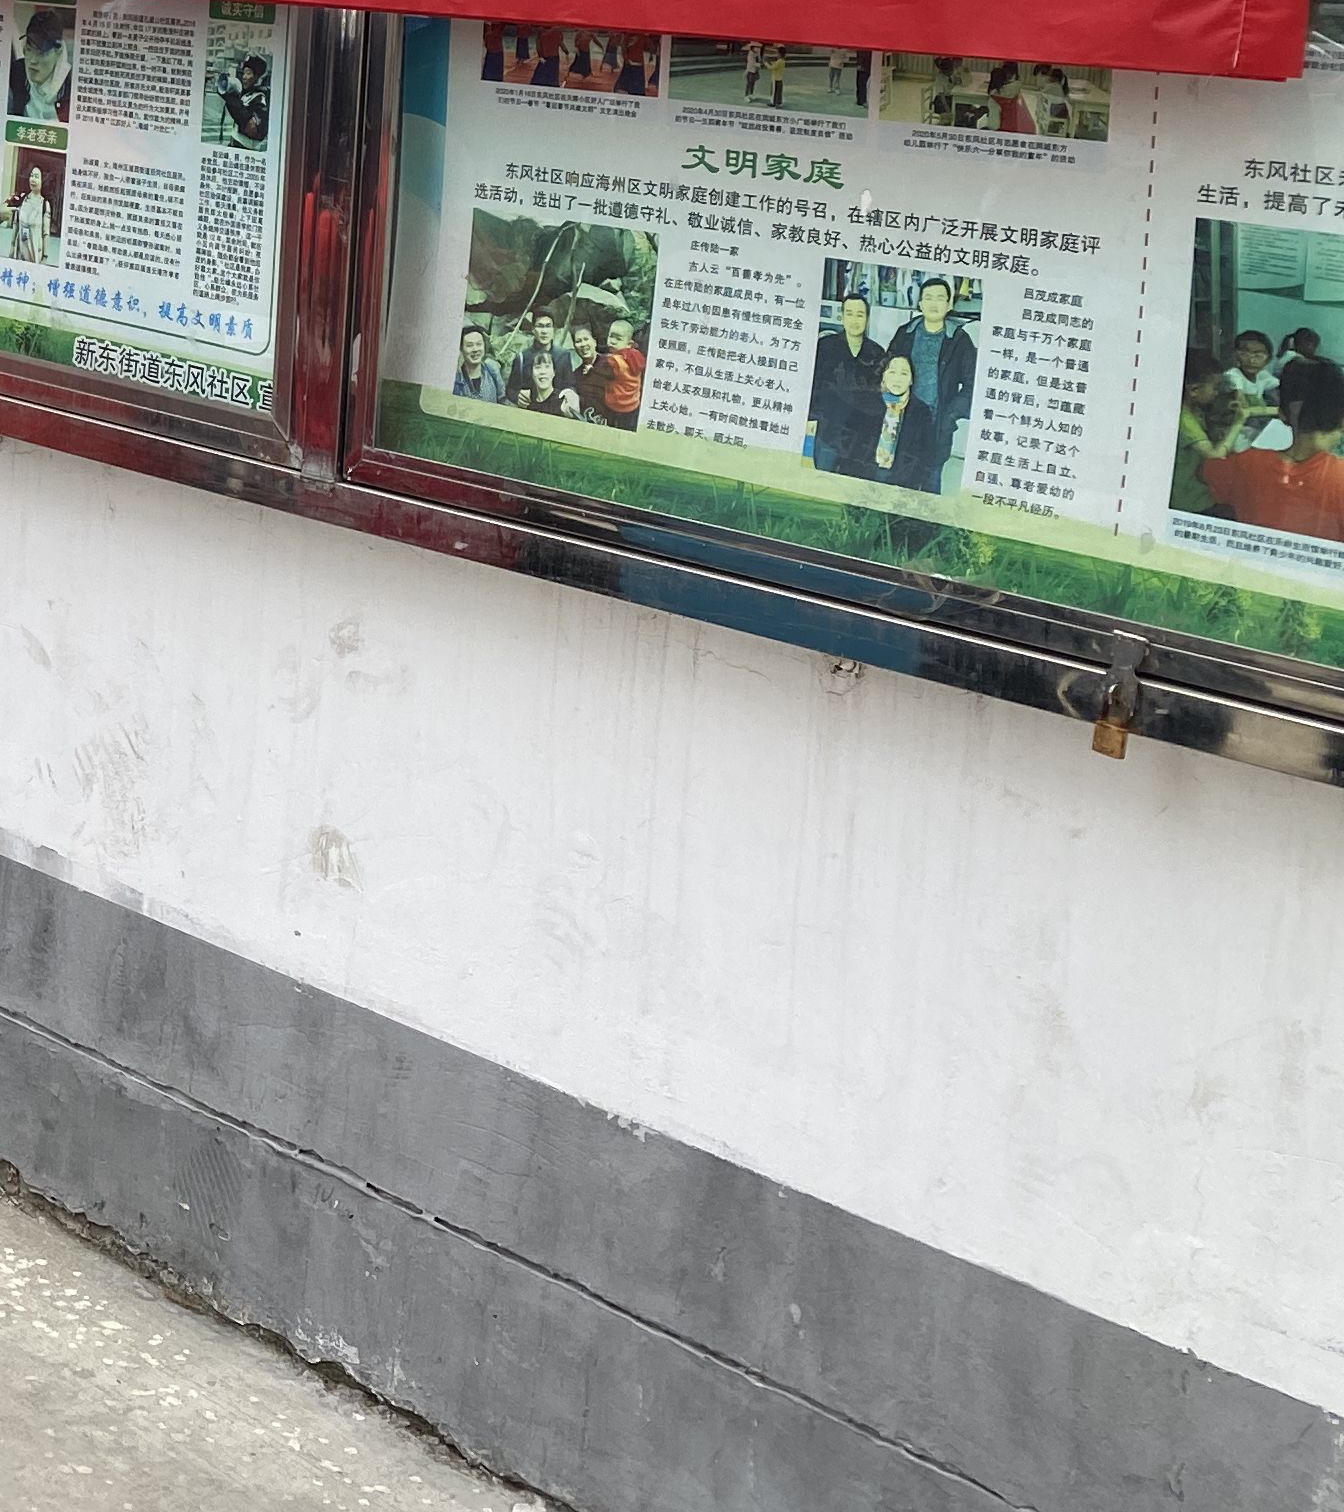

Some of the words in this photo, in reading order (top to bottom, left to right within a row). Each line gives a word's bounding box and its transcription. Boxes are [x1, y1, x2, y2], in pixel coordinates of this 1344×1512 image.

[681, 144, 845, 190] 文明家庭
[74, 337, 251, 409] 新东街道东风社区
